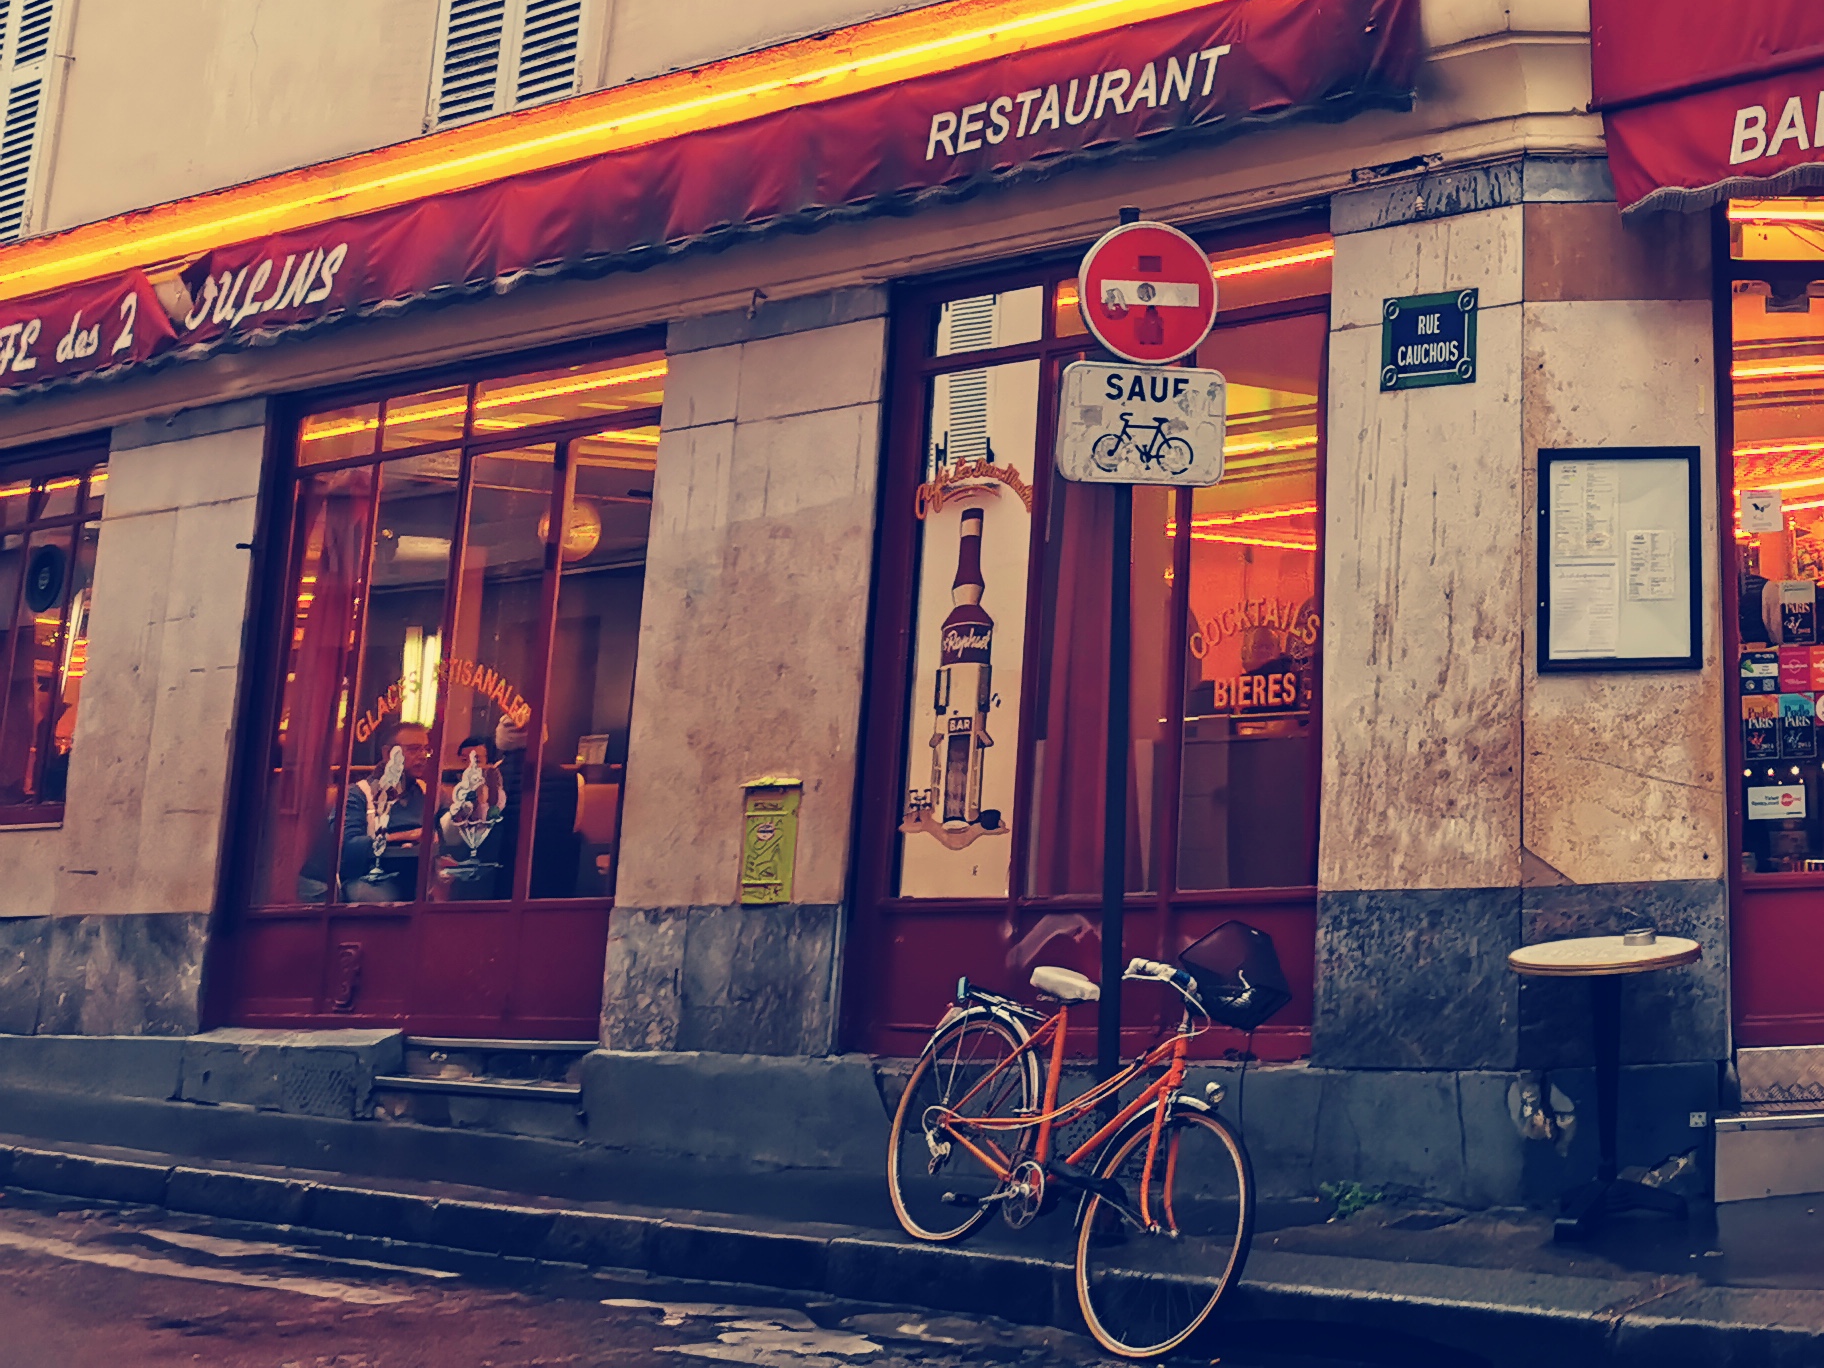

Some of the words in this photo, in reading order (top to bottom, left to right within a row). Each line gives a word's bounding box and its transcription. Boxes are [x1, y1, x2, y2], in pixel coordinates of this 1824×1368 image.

[925, 43, 1232, 161] RESTAURANT
[56, 309, 100, 354] des
[111, 291, 138, 347] 2
[184, 242, 349, 331] OULINS
[1417, 313, 1441, 335] RUE
[1397, 340, 1460, 367] CAUCHOIS
[1189, 596, 1321, 660] COCKTAILS
[949, 719, 971, 732] BAR
